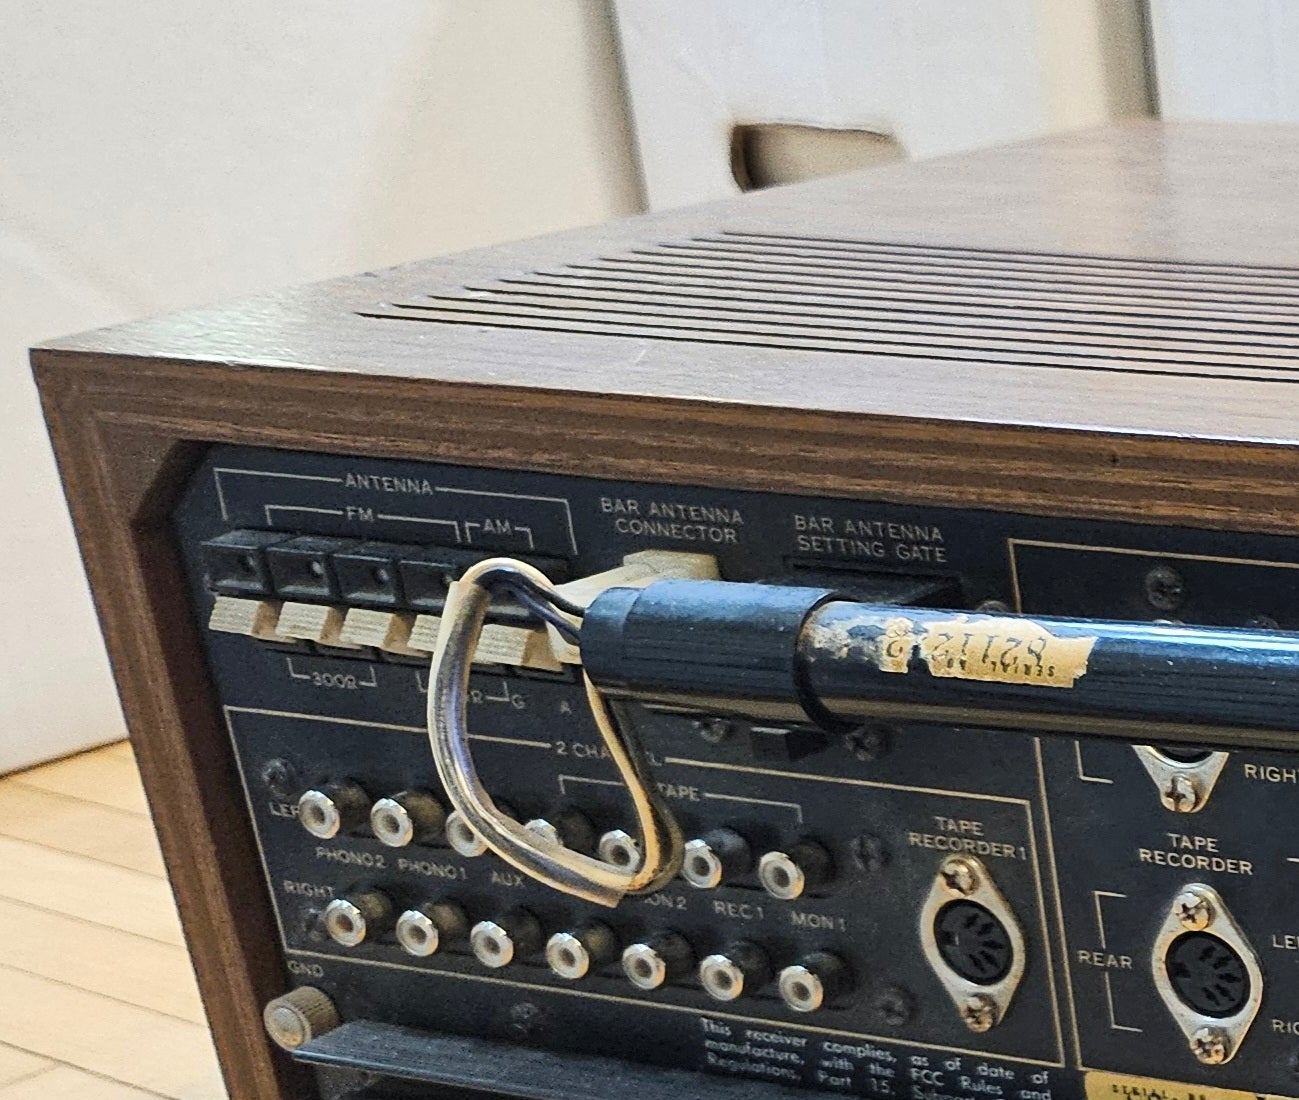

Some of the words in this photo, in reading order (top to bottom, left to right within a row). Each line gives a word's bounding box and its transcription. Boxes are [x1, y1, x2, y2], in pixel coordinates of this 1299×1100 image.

[345, 473, 434, 495] ANTENNA
[346, 506, 374, 522] FM
[600, 497, 639, 516] BAR
[649, 502, 744, 525] ANTENNA
[483, 519, 512, 535] AM
[615, 518, 740, 544] CONNECTOR
[794, 514, 835, 533] BAR
[844, 520, 944, 543] ANTENNA
[798, 535, 885, 559] SETTING
[896, 545, 948, 563] GATE
[555, 741, 568, 755] 2
[656, 782, 700, 802] TAPE
[934, 816, 984, 836] TAPE
[909, 832, 1016, 858] RECORDER
[1168, 833, 1219, 852] TAPE
[1139, 848, 1253, 875] RECORDER
[284, 880, 334, 897] RIGHT
[492, 870, 525, 887] AUX
[713, 900, 753, 920] REC
[791, 910, 834, 929] MON
[287, 961, 324, 978] GND
[1078, 950, 1132, 969] REAR
[701, 1017, 732, 1036] This
[746, 1030, 807, 1047] receiver
[823, 1041, 897, 1063] complies,
[910, 1055, 929, 1066] as
[945, 1057, 961, 1071] of
[977, 1062, 1015, 1079] date
[1031, 1071, 1049, 1084] of
[818, 1070, 851, 1086] Part
[821, 1056, 854, 1070] with
[869, 1062, 895, 1077] the
[910, 1068, 944, 1086] FCC
[960, 1076, 1003, 1094] Rules
